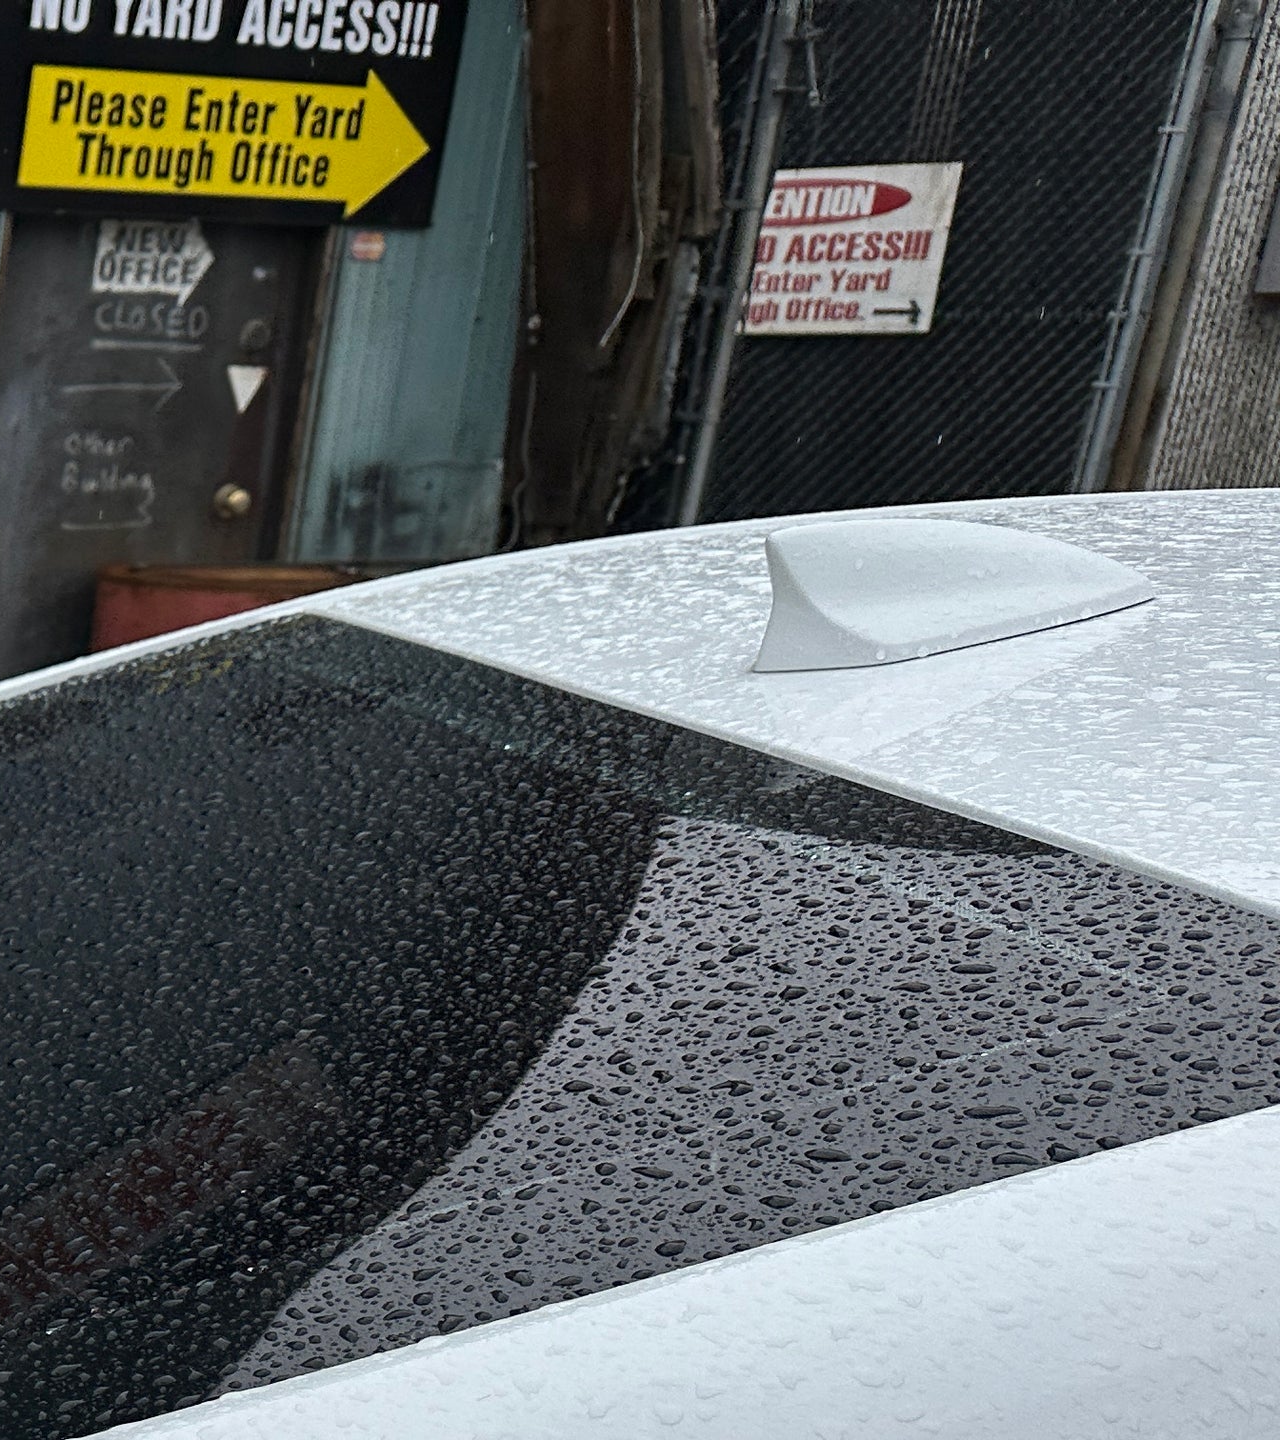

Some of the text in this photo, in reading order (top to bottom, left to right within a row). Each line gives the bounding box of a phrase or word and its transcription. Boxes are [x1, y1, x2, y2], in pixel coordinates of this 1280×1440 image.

[113, 0, 223, 42] YARD
[237, 0, 440, 58] ACCESS!!!
[51, 79, 366, 141] Please Enter Yard
[77, 132, 331, 189] Through Office
[764, 183, 877, 219] ENTION
[783, 230, 934, 264] ACCESS!!!
[98, 249, 202, 284] OFFICE
[752, 268, 892, 293] Enter Yard
[94, 300, 210, 338] CLOSED
